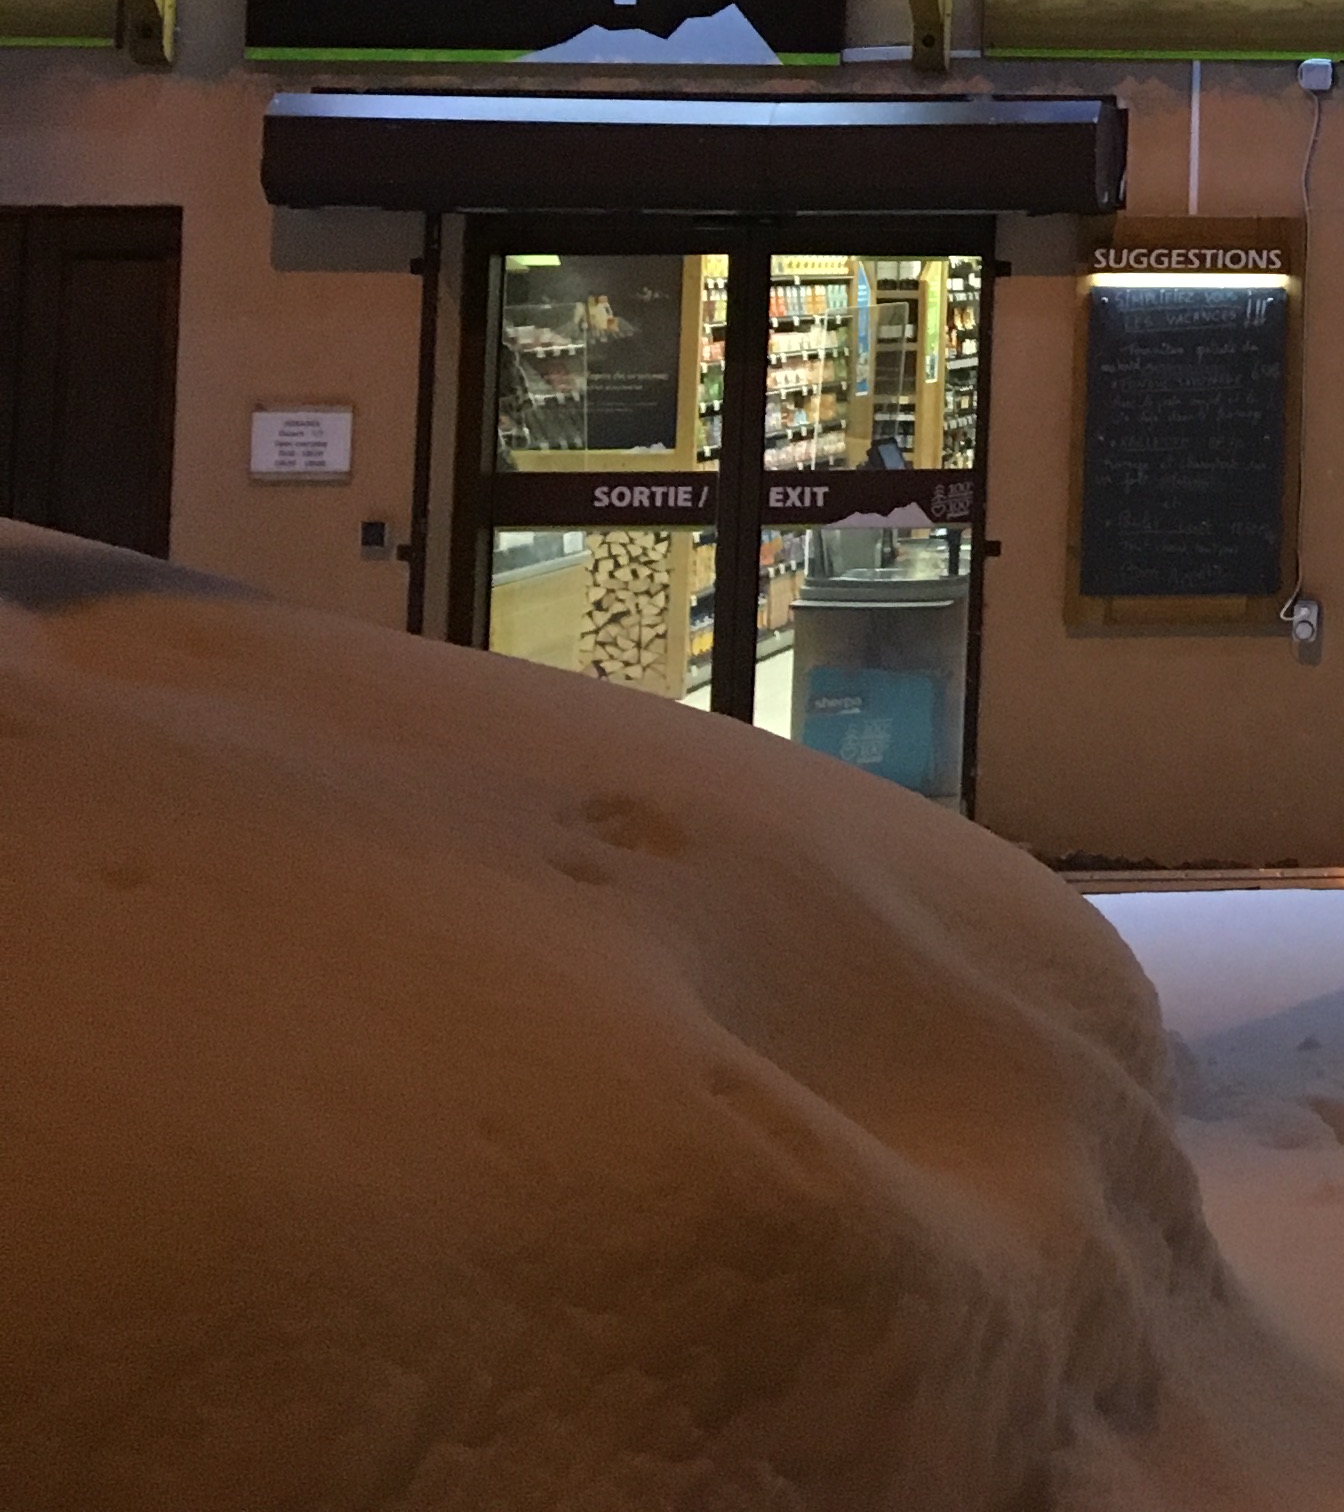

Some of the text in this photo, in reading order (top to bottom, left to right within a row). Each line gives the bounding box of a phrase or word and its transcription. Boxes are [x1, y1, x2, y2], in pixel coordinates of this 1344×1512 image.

[1094, 248, 1282, 269] SUGGESTIONS
[593, 486, 693, 507] SORTIE
[768, 486, 829, 507] EXIT
